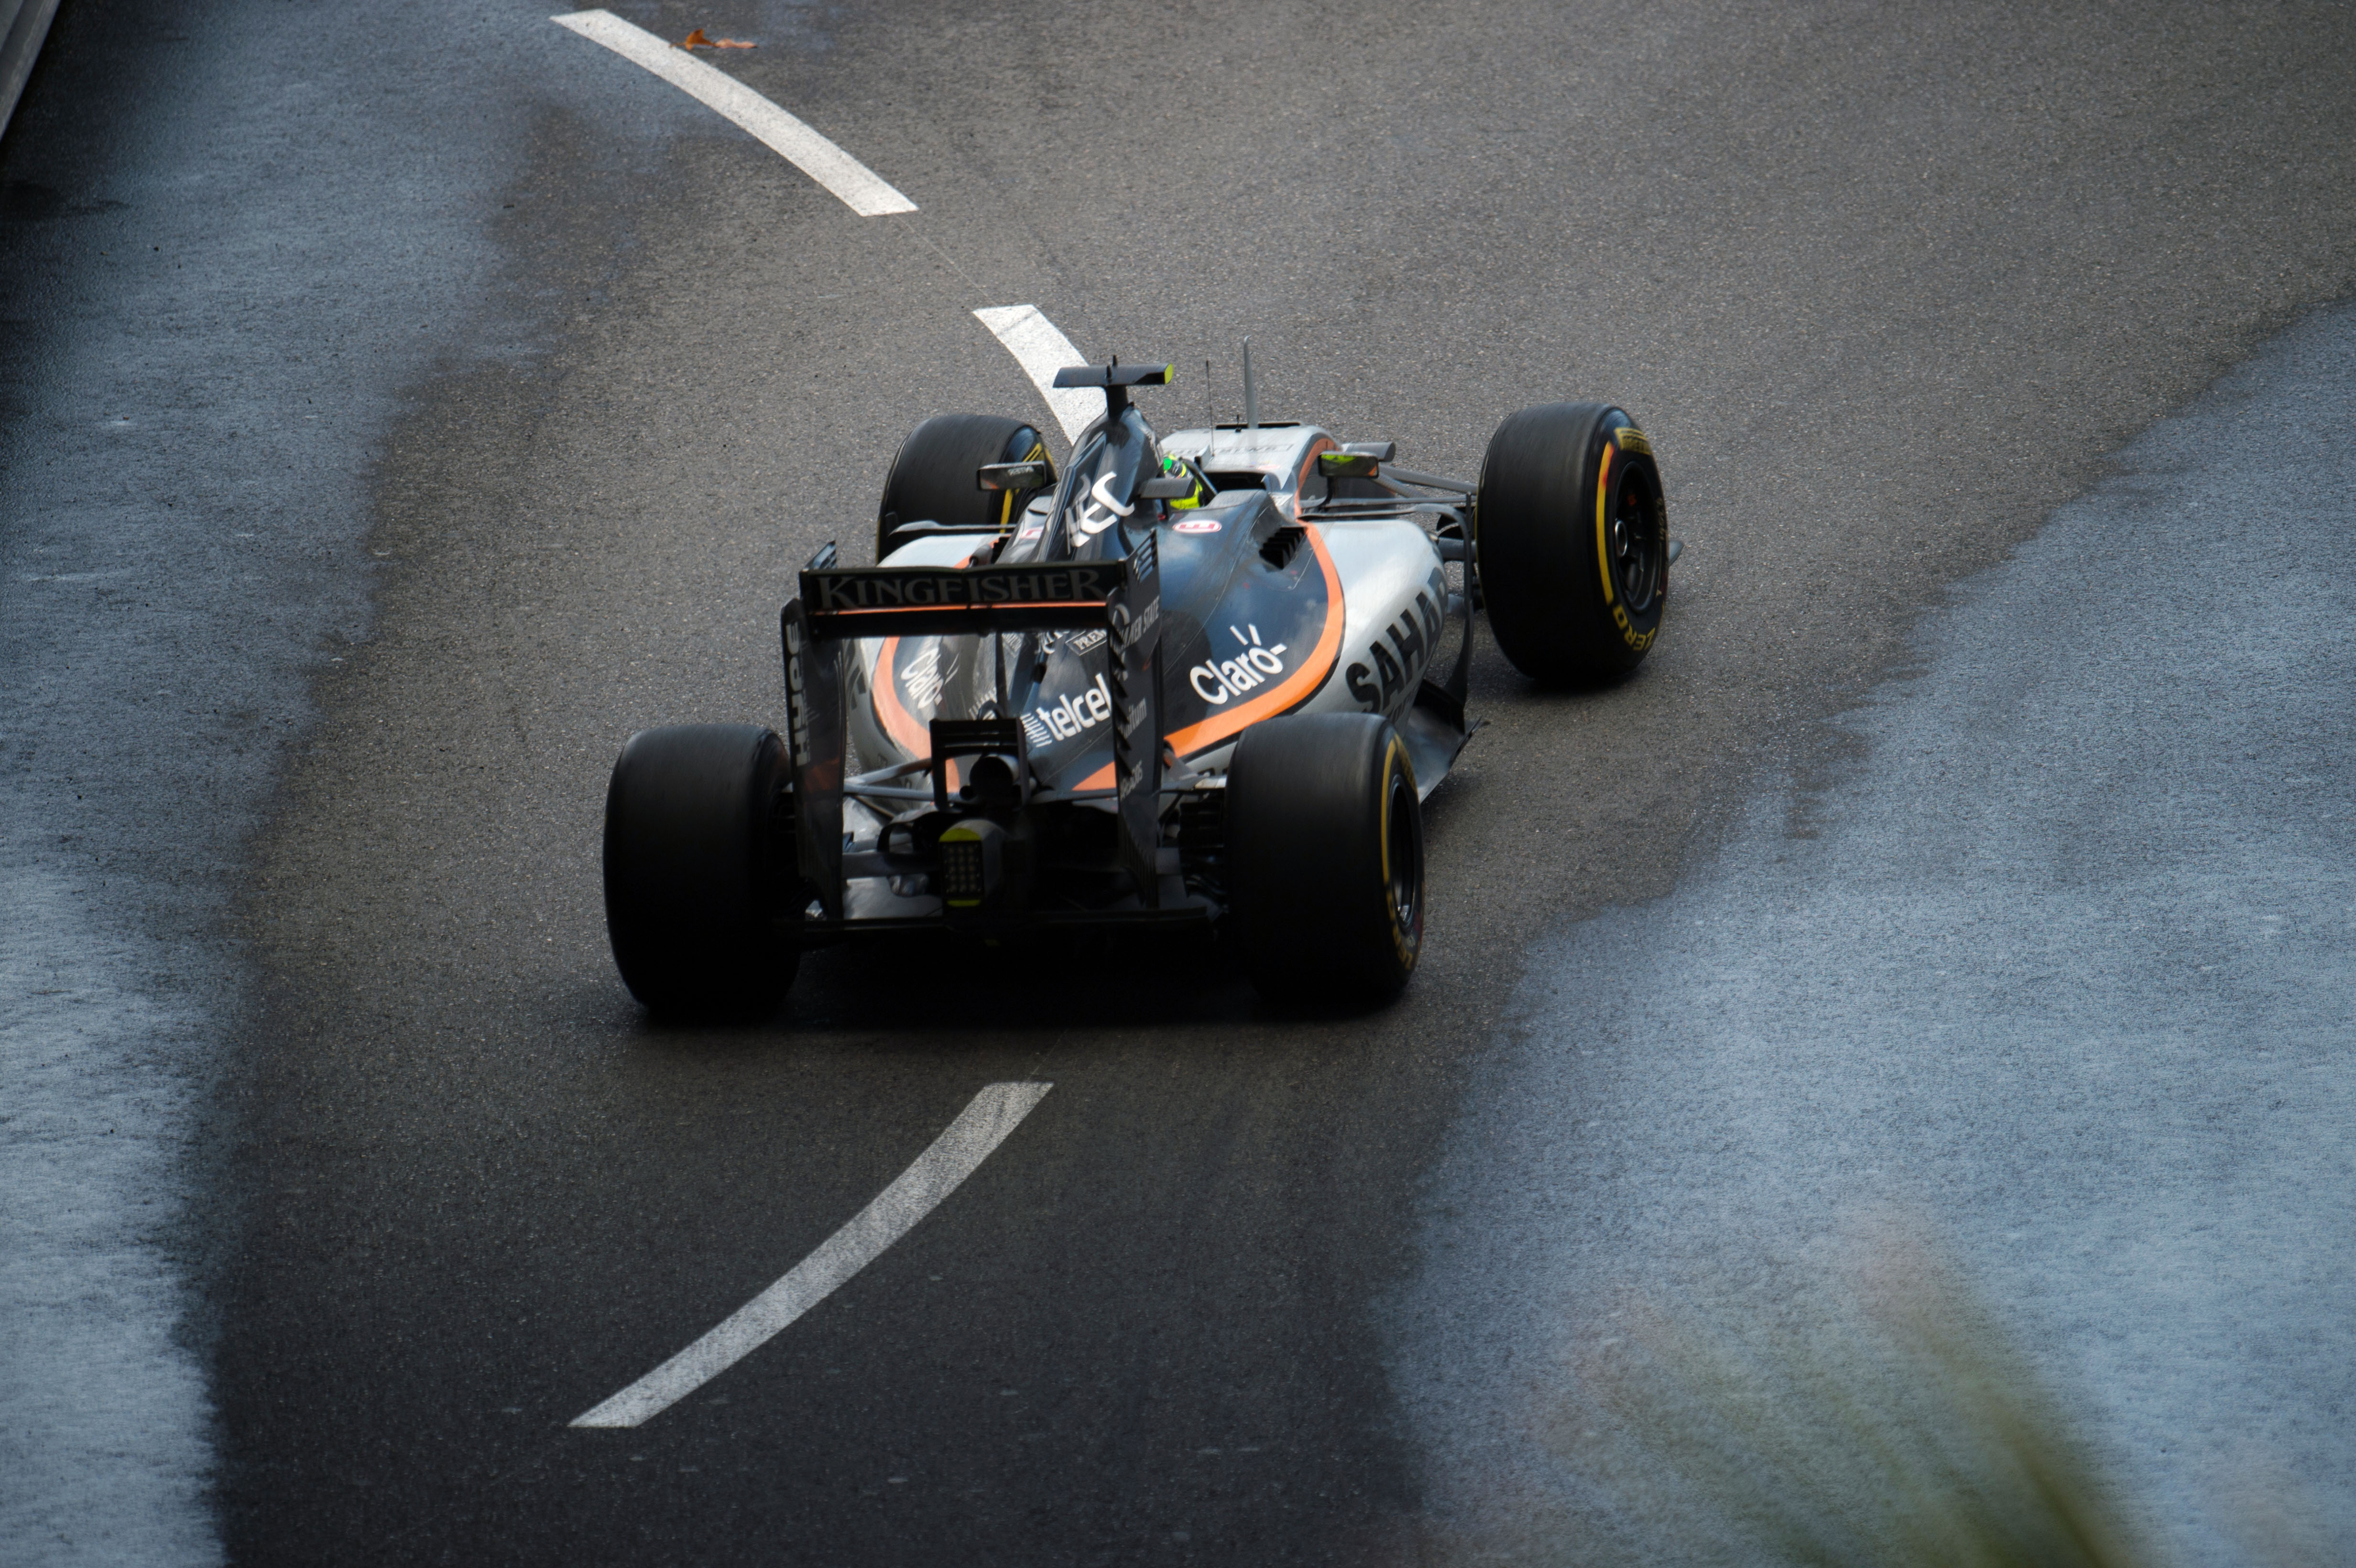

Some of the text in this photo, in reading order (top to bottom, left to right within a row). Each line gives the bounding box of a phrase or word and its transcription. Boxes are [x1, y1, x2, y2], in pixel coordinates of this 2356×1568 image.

[818, 569, 1106, 610] KINGFISHER
[1612, 602, 1657, 651] ZERO
[1189, 647, 1284, 705] Claro
[1036, 673, 1112, 741] telcel
